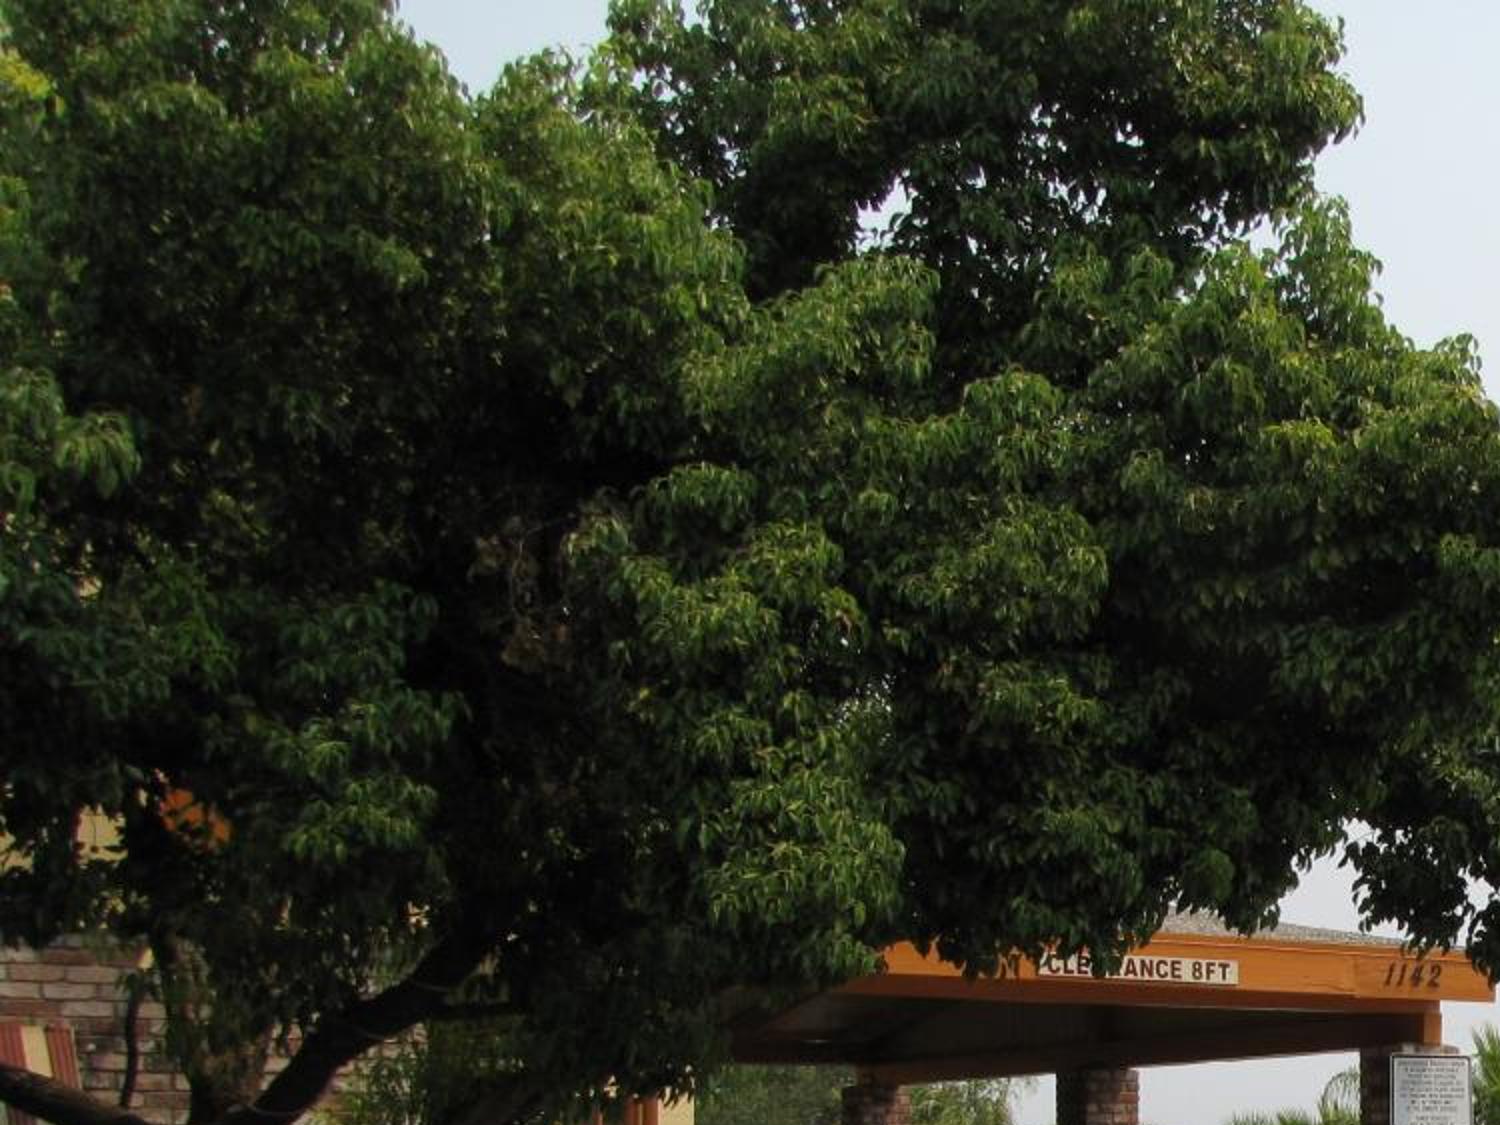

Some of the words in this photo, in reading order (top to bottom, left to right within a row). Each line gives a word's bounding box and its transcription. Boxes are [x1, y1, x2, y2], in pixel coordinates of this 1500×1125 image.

[1047, 953, 1183, 979] CLEANCE
[1191, 961, 1232, 981] 8FT
[1383, 961, 1442, 989] 1142
